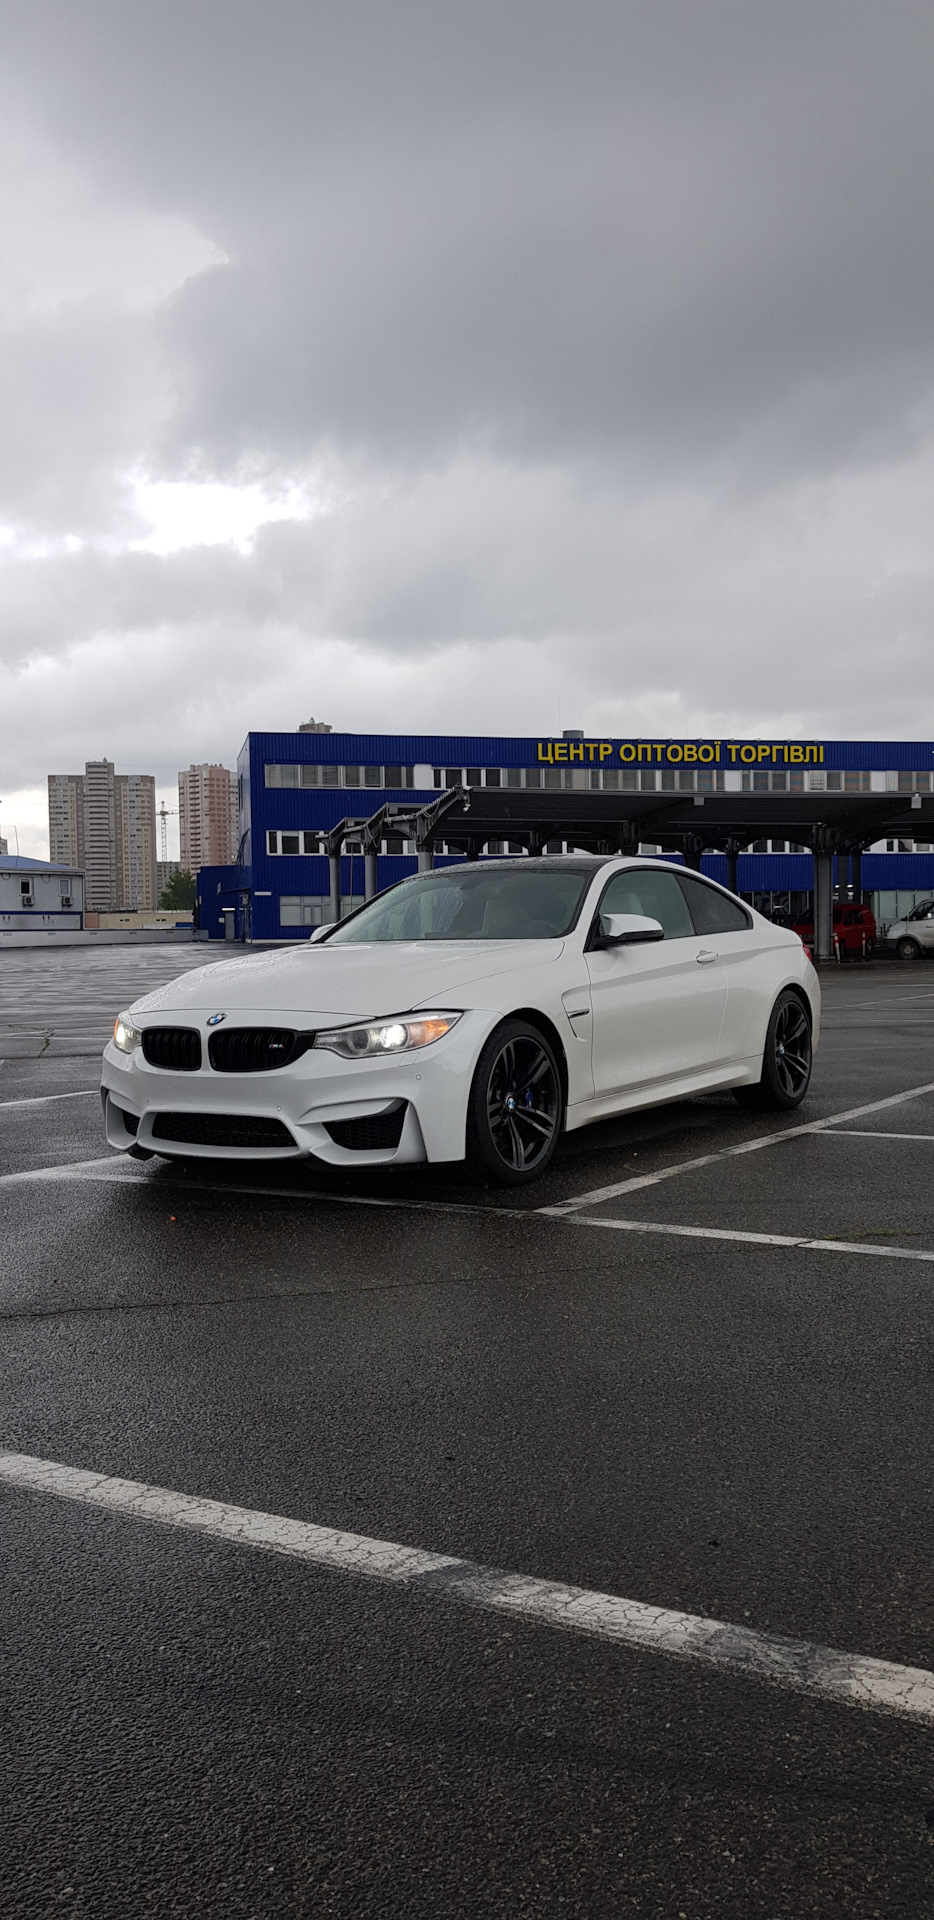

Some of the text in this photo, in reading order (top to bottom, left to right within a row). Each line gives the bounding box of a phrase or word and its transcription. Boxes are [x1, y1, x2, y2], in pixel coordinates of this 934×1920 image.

[537, 741, 824, 764] ЦЕНТР ОПТОВОЇ ТОРГІВЛІ
